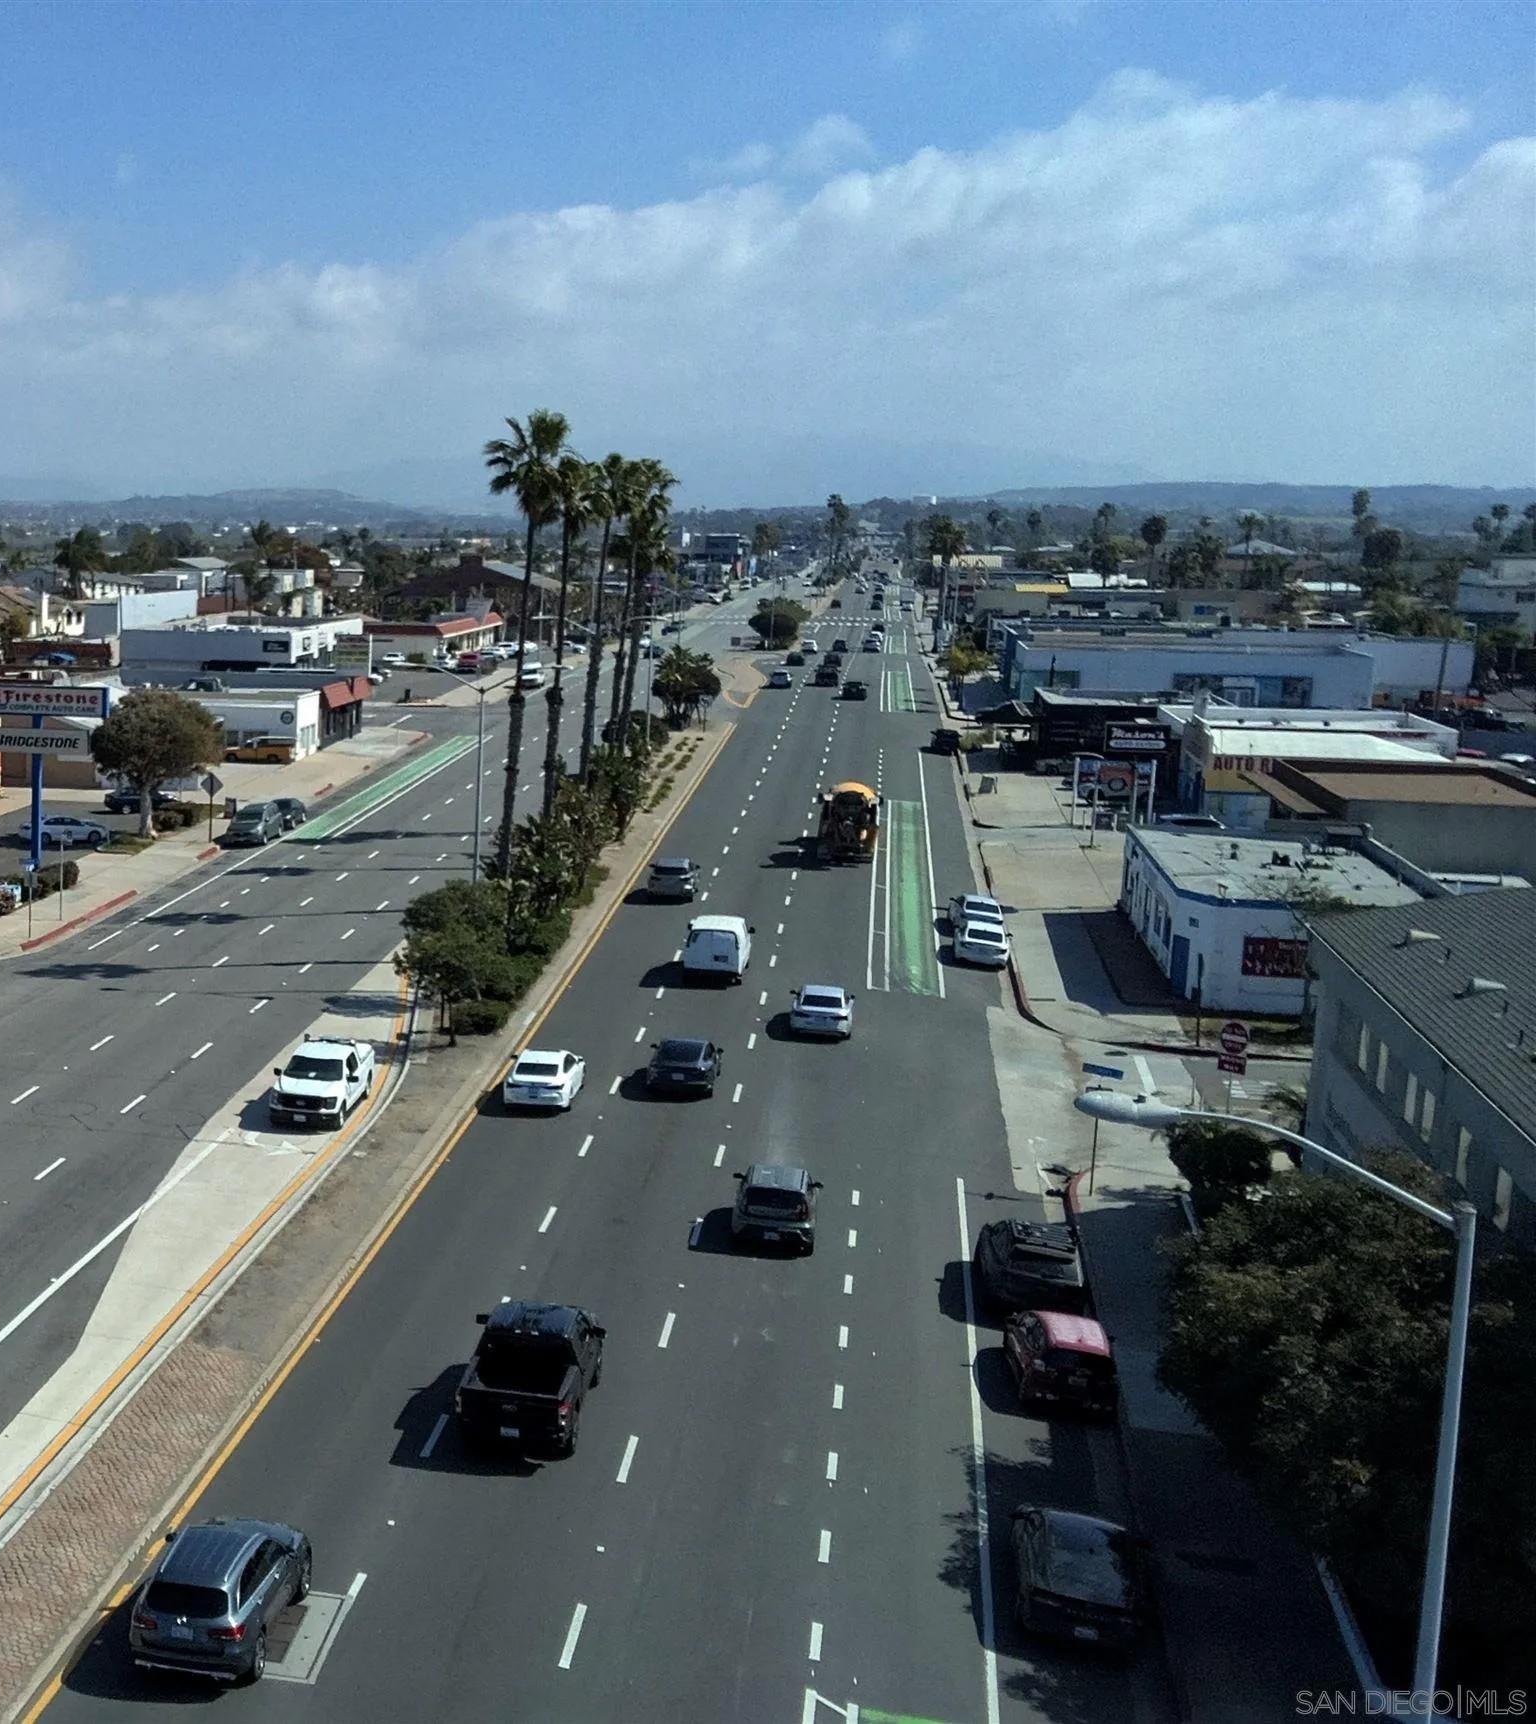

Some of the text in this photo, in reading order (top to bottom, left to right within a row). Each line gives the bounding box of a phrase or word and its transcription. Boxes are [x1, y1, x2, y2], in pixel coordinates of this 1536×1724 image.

[2, 690, 98, 705] Firestone
[9, 704, 50, 712] COMPLETE
[75, 705, 96, 713] CARE
[1214, 756, 1255, 771] AUTO
